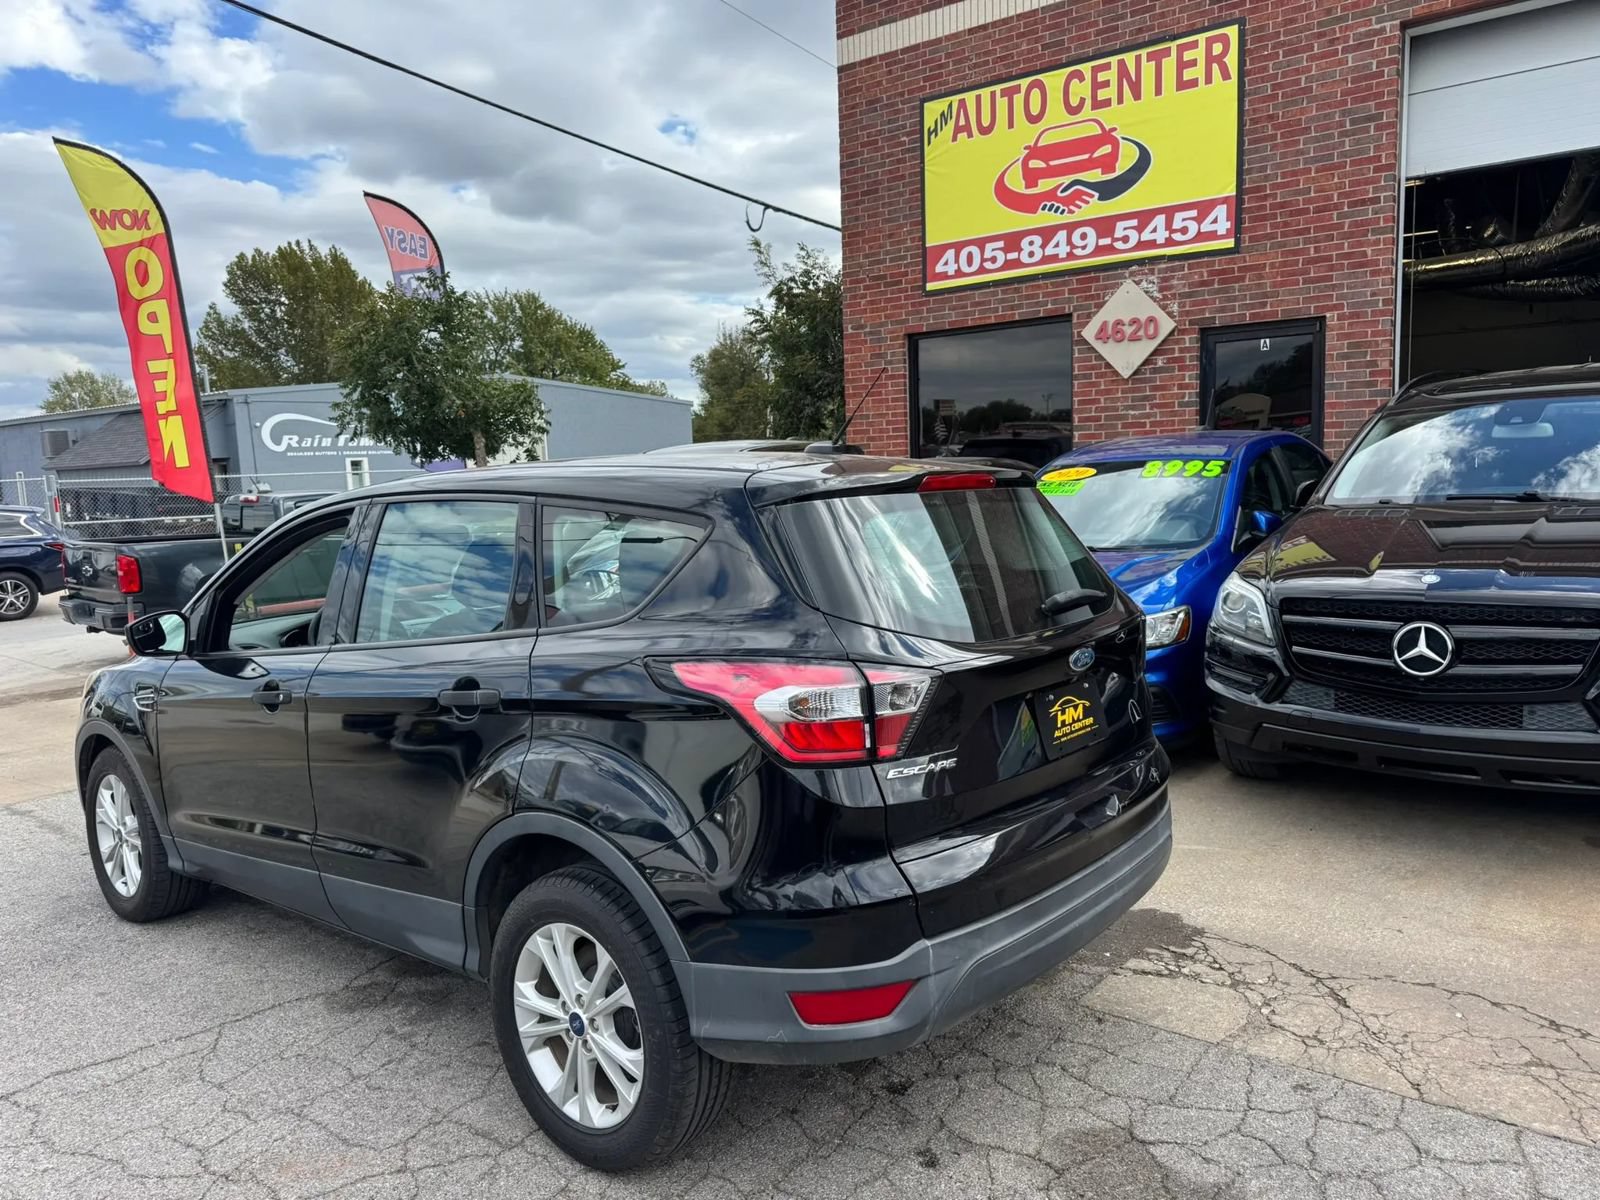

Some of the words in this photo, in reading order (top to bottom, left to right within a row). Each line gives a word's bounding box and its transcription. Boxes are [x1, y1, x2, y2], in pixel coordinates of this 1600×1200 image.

[927, 101, 953, 146] HM
[951, 78, 1048, 143] AUTO
[1062, 32, 1232, 117] CENTER
[935, 204, 1231, 276] 405-849-5454
[1095, 315, 1159, 344] 4620
[1261, 339, 1269, 351] A
[282, 434, 332, 448] Rain
[1141, 460, 1226, 477] 8995
[1058, 703, 1084, 728] HM
[1054, 726, 1070, 738] AUTO
[1072, 717, 1093, 730] CENTER
[886, 758, 957, 779] ESCAPE
